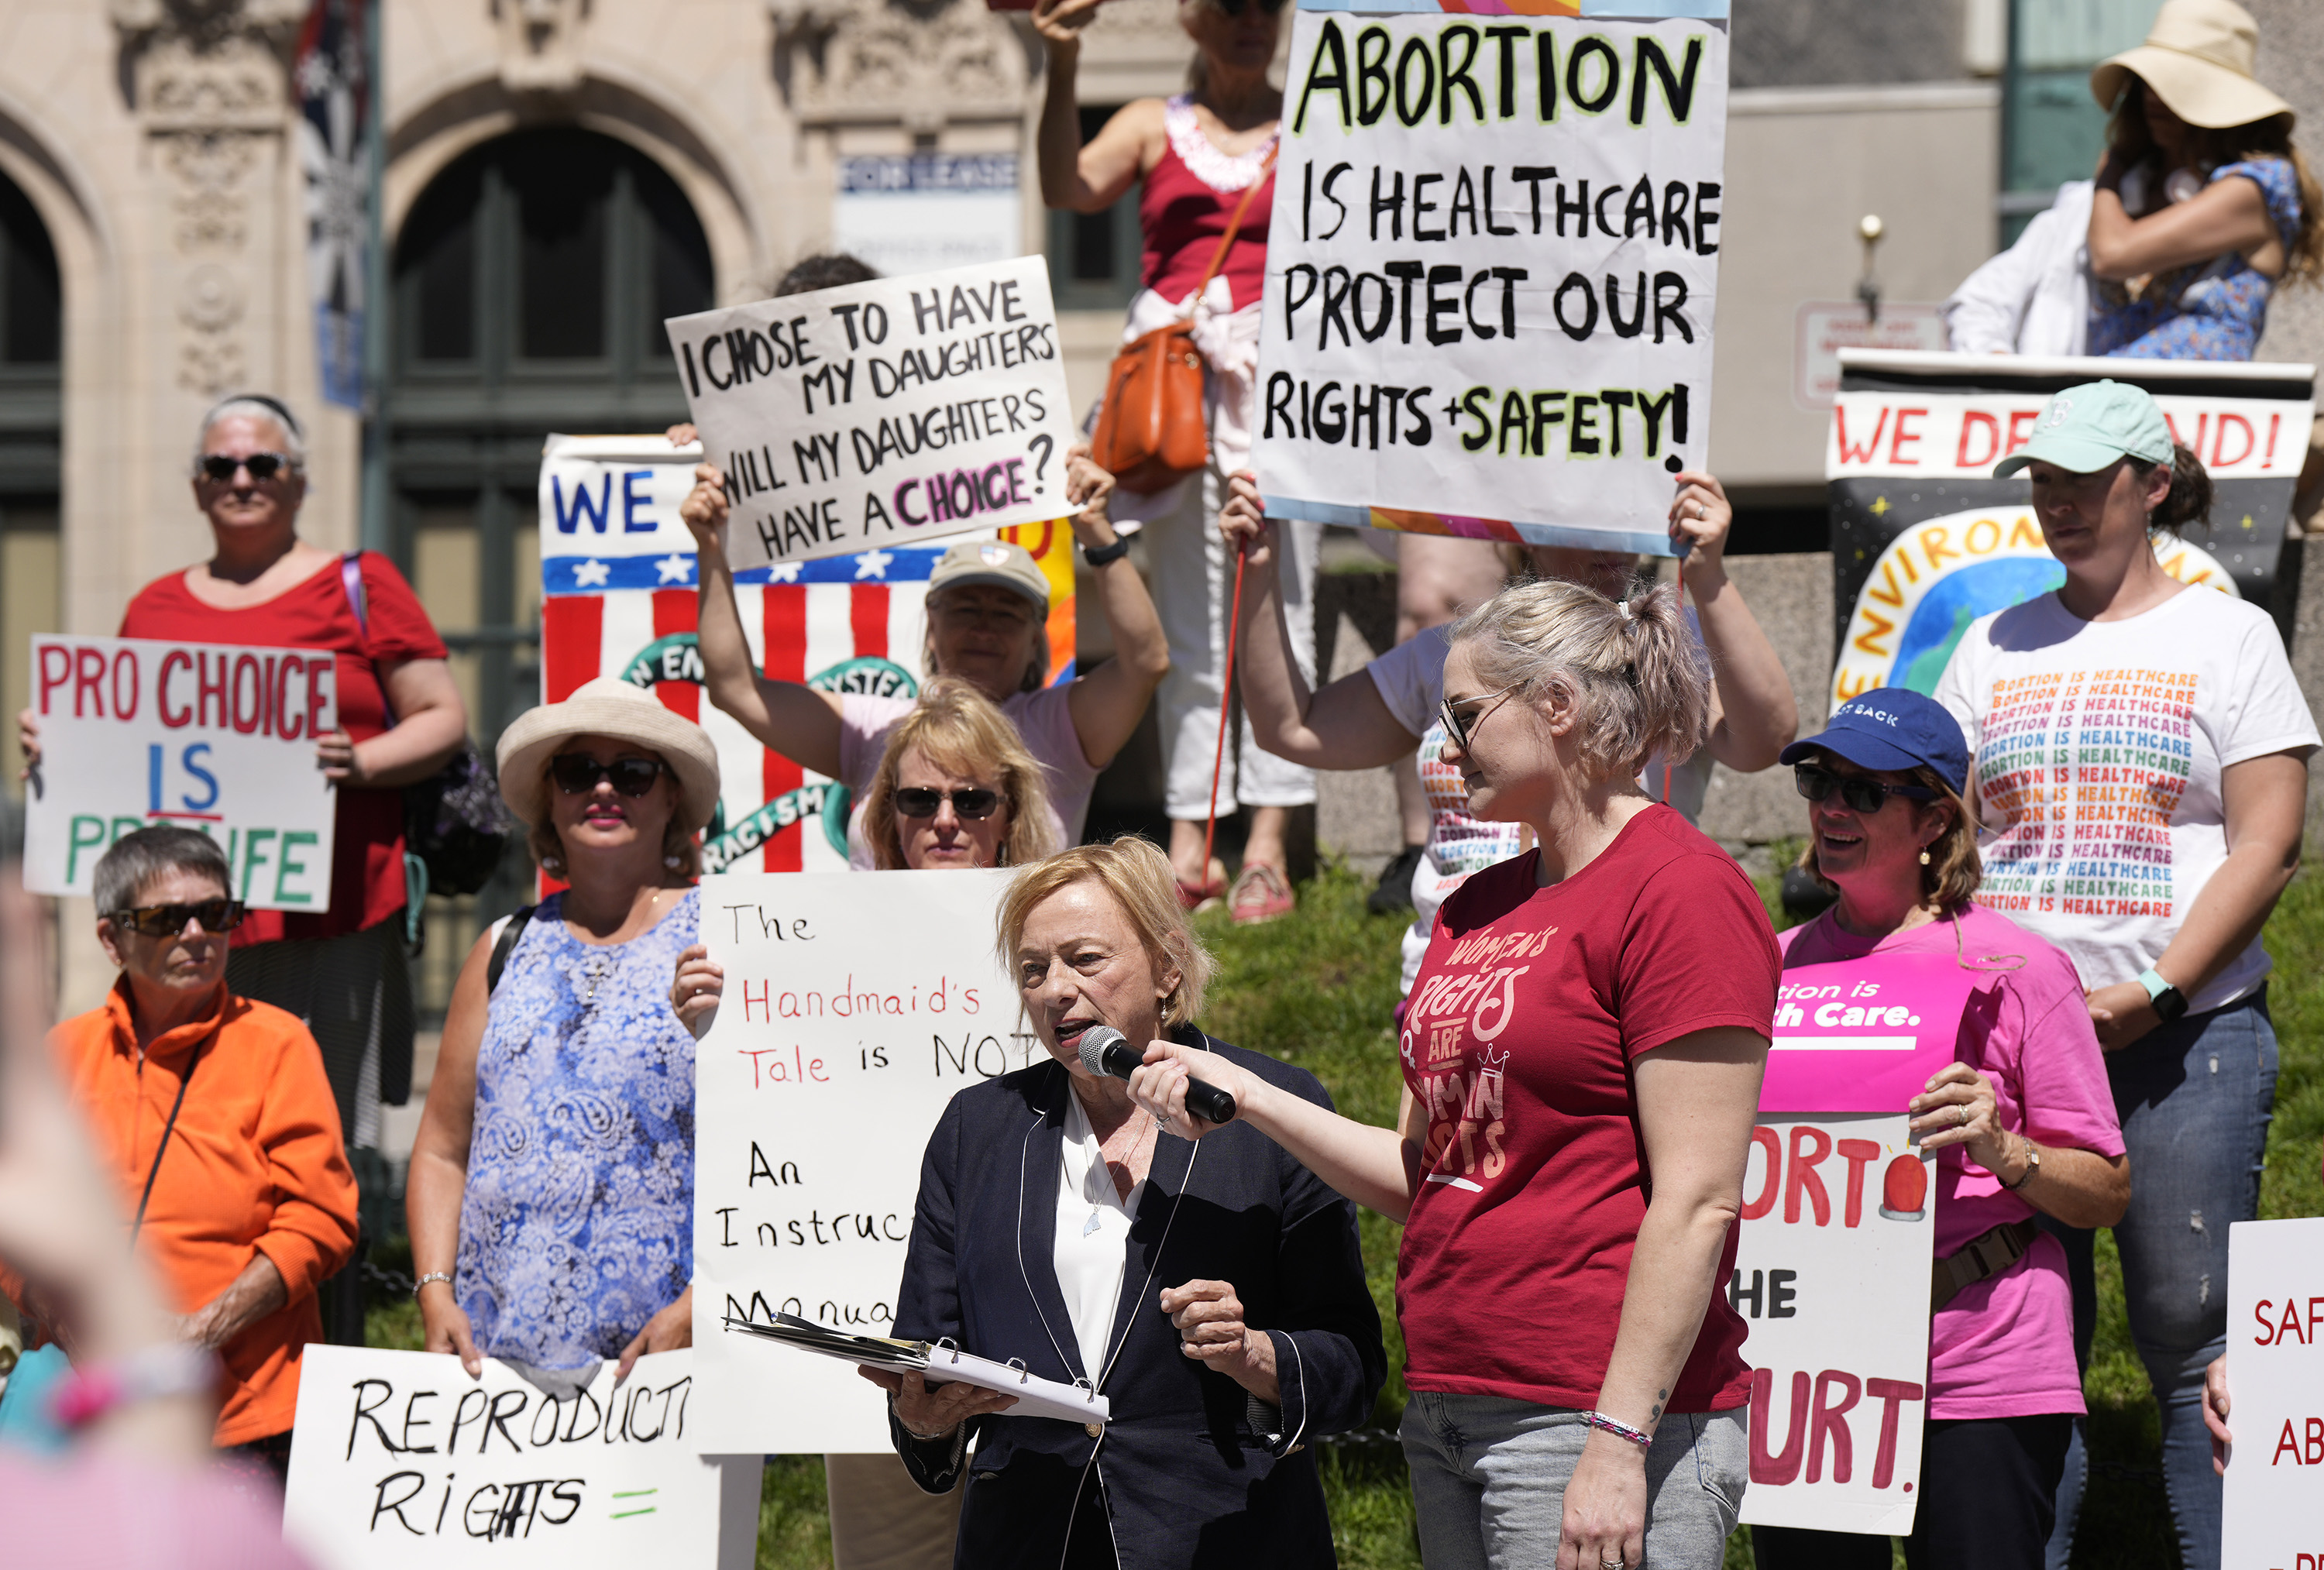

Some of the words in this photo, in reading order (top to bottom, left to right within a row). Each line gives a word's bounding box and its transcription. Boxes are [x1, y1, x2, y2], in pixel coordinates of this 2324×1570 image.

[1293, 18, 1702, 134] ABORTION
[1303, 160, 1353, 241] IS
[1370, 165, 1721, 256] HEALTHCARE
[1285, 260, 1528, 350] PROTECT
[1553, 271, 1694, 344] OUR
[682, 342, 700, 397] I
[703, 315, 820, 390] CHOSE
[831, 303, 888, 351] TO
[910, 280, 1026, 335] HAVE
[803, 359, 854, 414] MY
[869, 324, 1054, 398] DAUGHTERS
[1263, 371, 1432, 450] RIGHTS
[792, 432, 840, 484] MY
[851, 388, 1047, 475] DAUGHTERS
[1834, 405, 1928, 466] WE
[1954, 411, 2281, 469] DEND!
[552, 470, 658, 535] WE
[757, 498, 845, 560] HAVE
[865, 493, 893, 535] A
[39, 644, 140, 722] PRO
[158, 649, 333, 740] CHOICE
[1992, 687, 2058, 709] BORTION
[2066, 685, 2082, 696] IS
[2089, 683, 2195, 705] HEALTHCARE
[2071, 671, 2086, 682] IS
[2093, 669, 2199, 687] HEALTHCARE
[1855, 703, 1899, 727] BACK
[2058, 715, 2073, 728] IS
[2082, 714, 2192, 738] HEALTHCARE
[2061, 699, 2076, 712] IS
[2085, 698, 2193, 720] HEALTHCARE
[2054, 731, 2070, 745] IS
[2079, 730, 2192, 758] HEALTHCARE
[2054, 748, 2069, 764] IS
[2078, 747, 2192, 776] HEALTHCARE
[148, 741, 220, 812] IS
[2054, 768, 2069, 783] IS
[2078, 767, 2188, 795] HEALTHCARE
[2054, 786, 2068, 802] IS
[2076, 785, 2181, 812] HEALTHCARE
[700, 785, 826, 874] RACISM
[1435, 826, 1501, 843] BORTION
[2052, 824, 2065, 840] IS
[2074, 824, 2172, 846] HEALTHCARE
[2053, 806, 2067, 821] IS
[2075, 806, 2172, 828] HEALTHCARE
[201, 823, 318, 903] IFE
[2045, 862, 2061, 875] IS
[2066, 861, 2173, 881] HEALTHCARE
[2048, 843, 2064, 858] IS
[2071, 843, 2173, 864] HEALTHCARE
[2038, 897, 2054, 912] IS
[2062, 898, 2173, 918] HEALTHCARE
[2040, 878, 2056, 894] IS
[2063, 878, 2173, 899] HEALTHCARE
[723, 904, 816, 944] The
[1444, 926, 1559, 974] WOMEN'S
[743, 974, 980, 1023] Handmaid's
[1406, 965, 1530, 1042] RIGHTS
[1850, 980, 1881, 998] is
[1814, 1002, 1921, 1028] Care.
[737, 1045, 830, 1089] Tale
[858, 1040, 889, 1070] is
[933, 1032, 1037, 1078] NOT
[1428, 1025, 1464, 1062] ARE
[748, 1140, 803, 1188] An
[1741, 1125, 1881, 1228] ORT
[715, 1207, 914, 1248] Instruc
[1731, 1269, 1796, 1318] HE
[2254, 1297, 2324, 1346] SAF
[2271, 1417, 2324, 1466] AB
